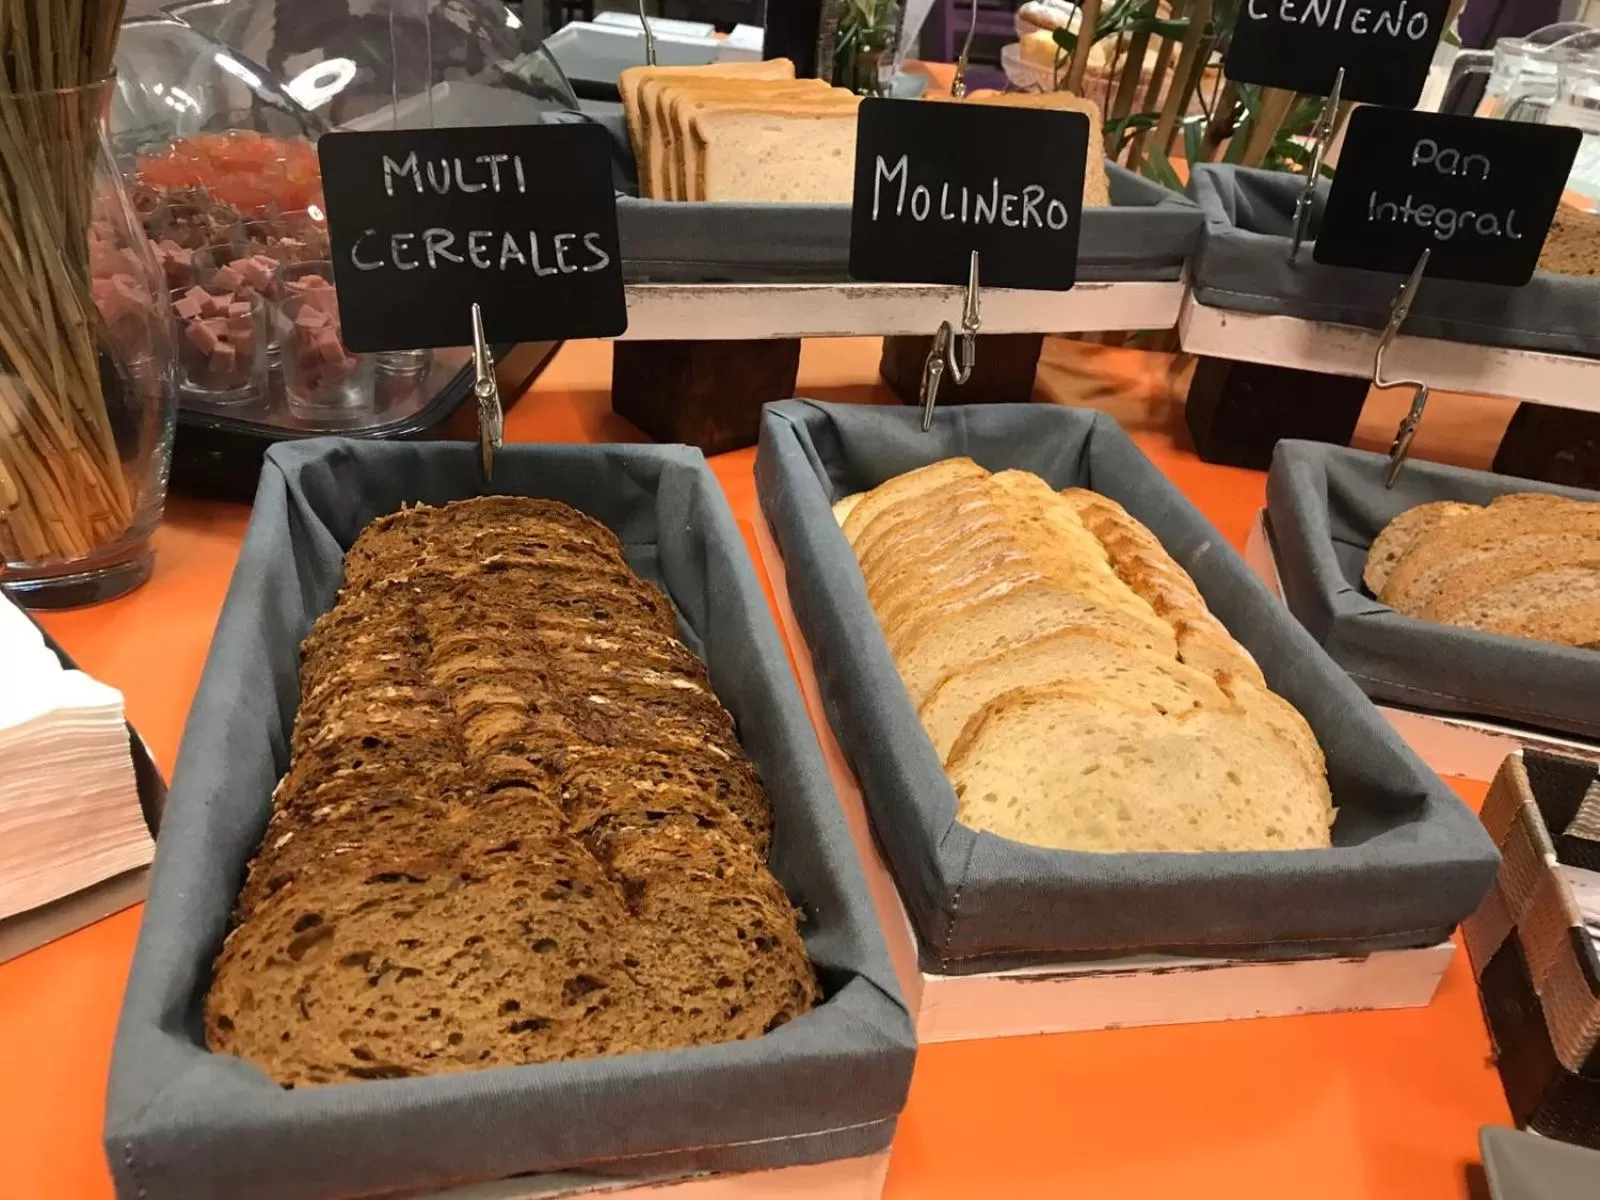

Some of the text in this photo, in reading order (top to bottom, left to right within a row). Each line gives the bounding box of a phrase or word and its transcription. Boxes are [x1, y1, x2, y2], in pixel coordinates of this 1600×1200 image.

[383, 151, 526, 196] MULTI
[872, 154, 1068, 230] MOLINERO
[1368, 191, 1522, 240] Integral
[351, 227, 610, 276] CEREALES
